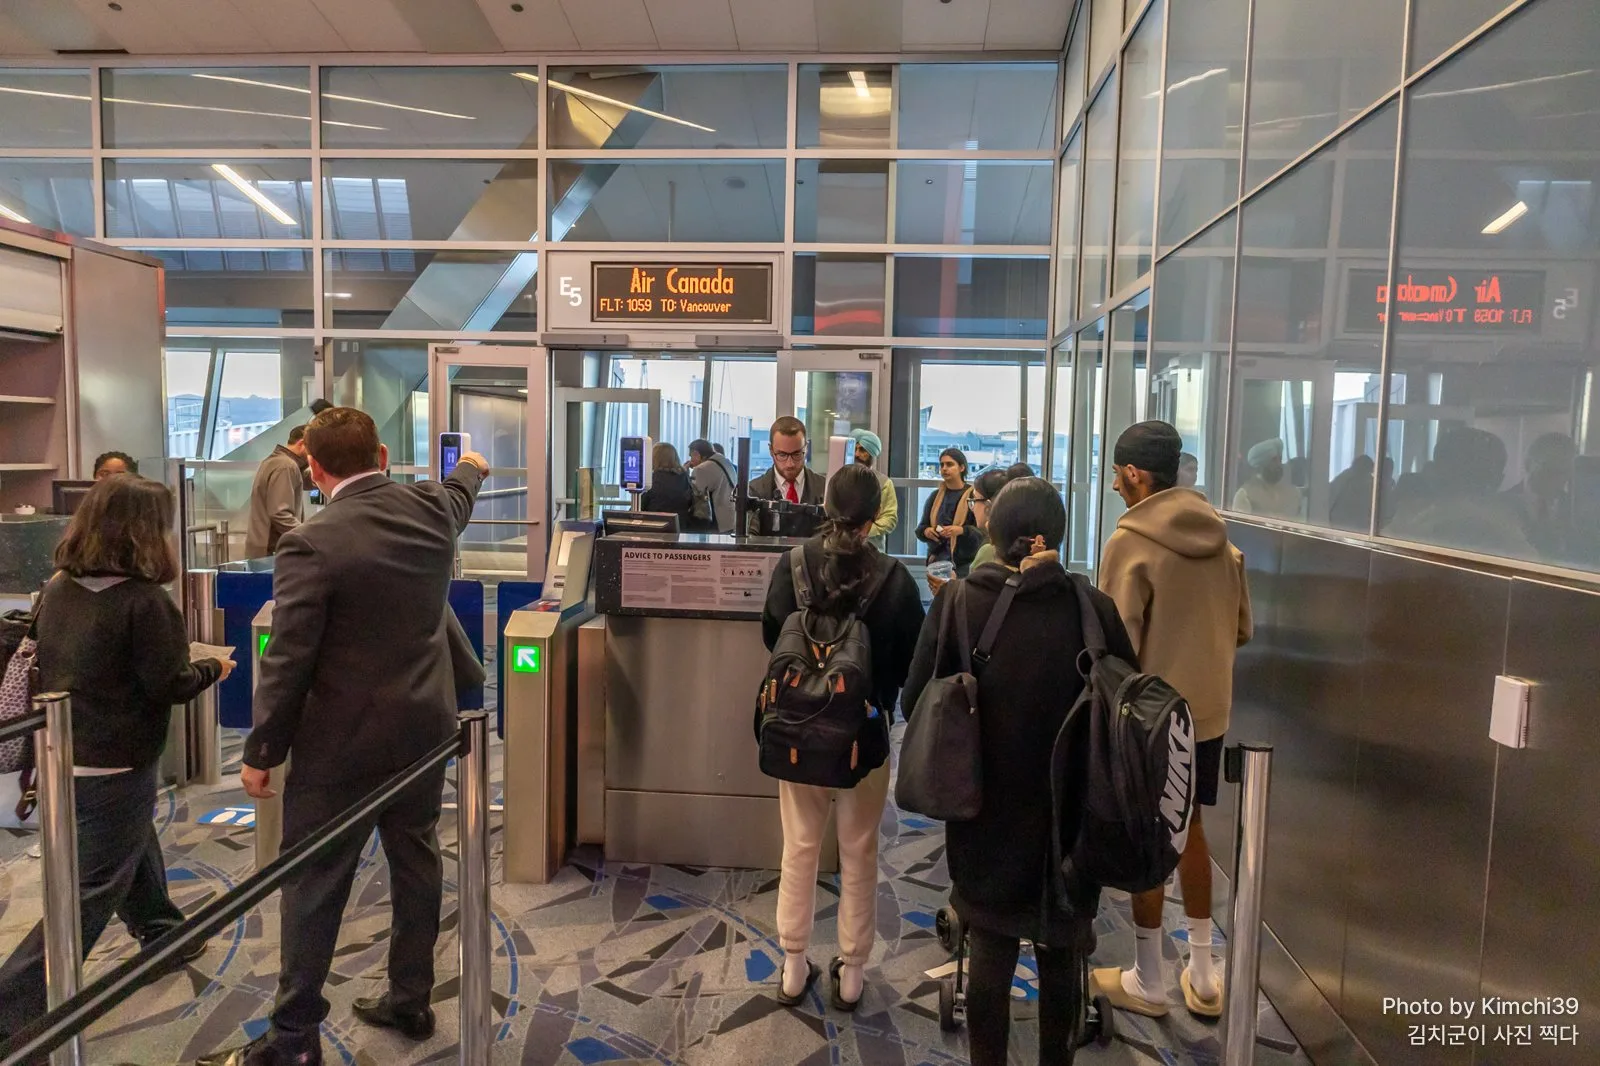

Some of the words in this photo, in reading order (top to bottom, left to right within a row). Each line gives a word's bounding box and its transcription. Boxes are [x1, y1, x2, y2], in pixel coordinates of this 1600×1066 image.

[560, 277, 583, 307] E5
[630, 267, 655, 293] Air
[666, 267, 734, 294] Canada
[600, 298, 624, 312] FLT:
[627, 298, 652, 312] 1059
[660, 298, 677, 312] TO:
[680, 299, 732, 313] Vancouver
[624, 551, 651, 560] ADVICE
[652, 552, 663, 560] TO
[664, 553, 711, 562] PASSENGERS
[1160, 710, 1191, 831] NIKE
